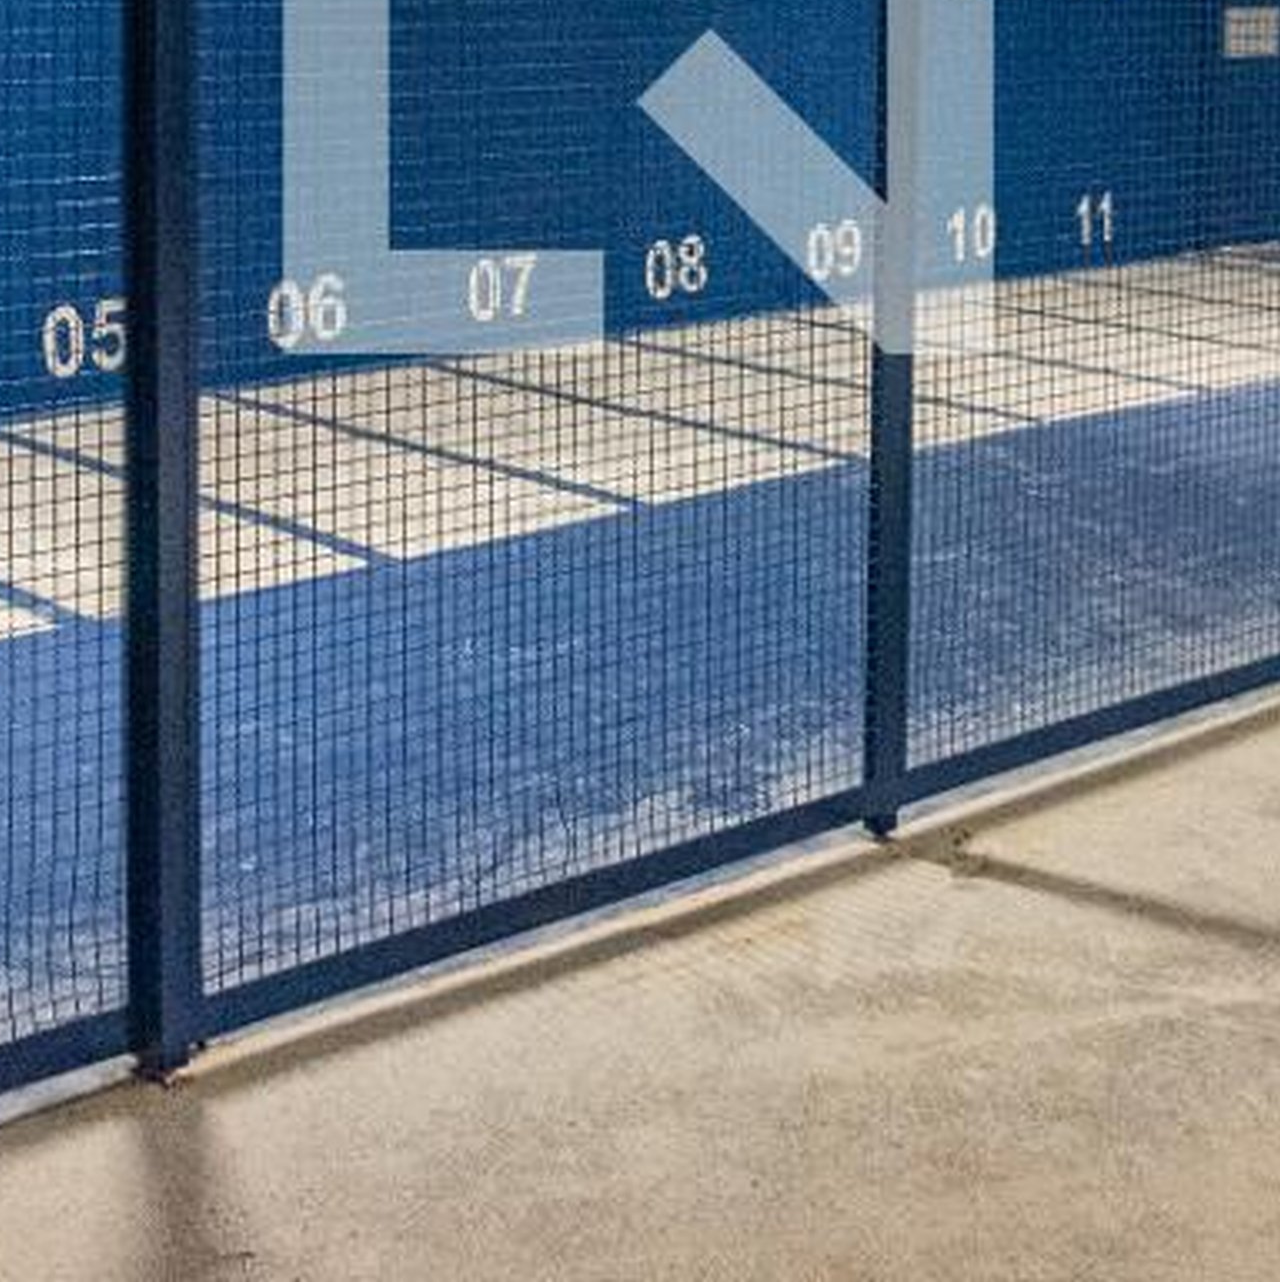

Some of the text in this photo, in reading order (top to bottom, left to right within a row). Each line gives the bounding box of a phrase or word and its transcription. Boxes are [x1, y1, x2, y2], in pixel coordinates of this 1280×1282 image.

[806, 218, 863, 281] 09
[946, 205, 996, 262] 10
[1075, 191, 1115, 246] 11
[466, 252, 538, 322] 07
[644, 235, 708, 300] 08
[42, 299, 127, 378] 05
[267, 275, 347, 349] 06
